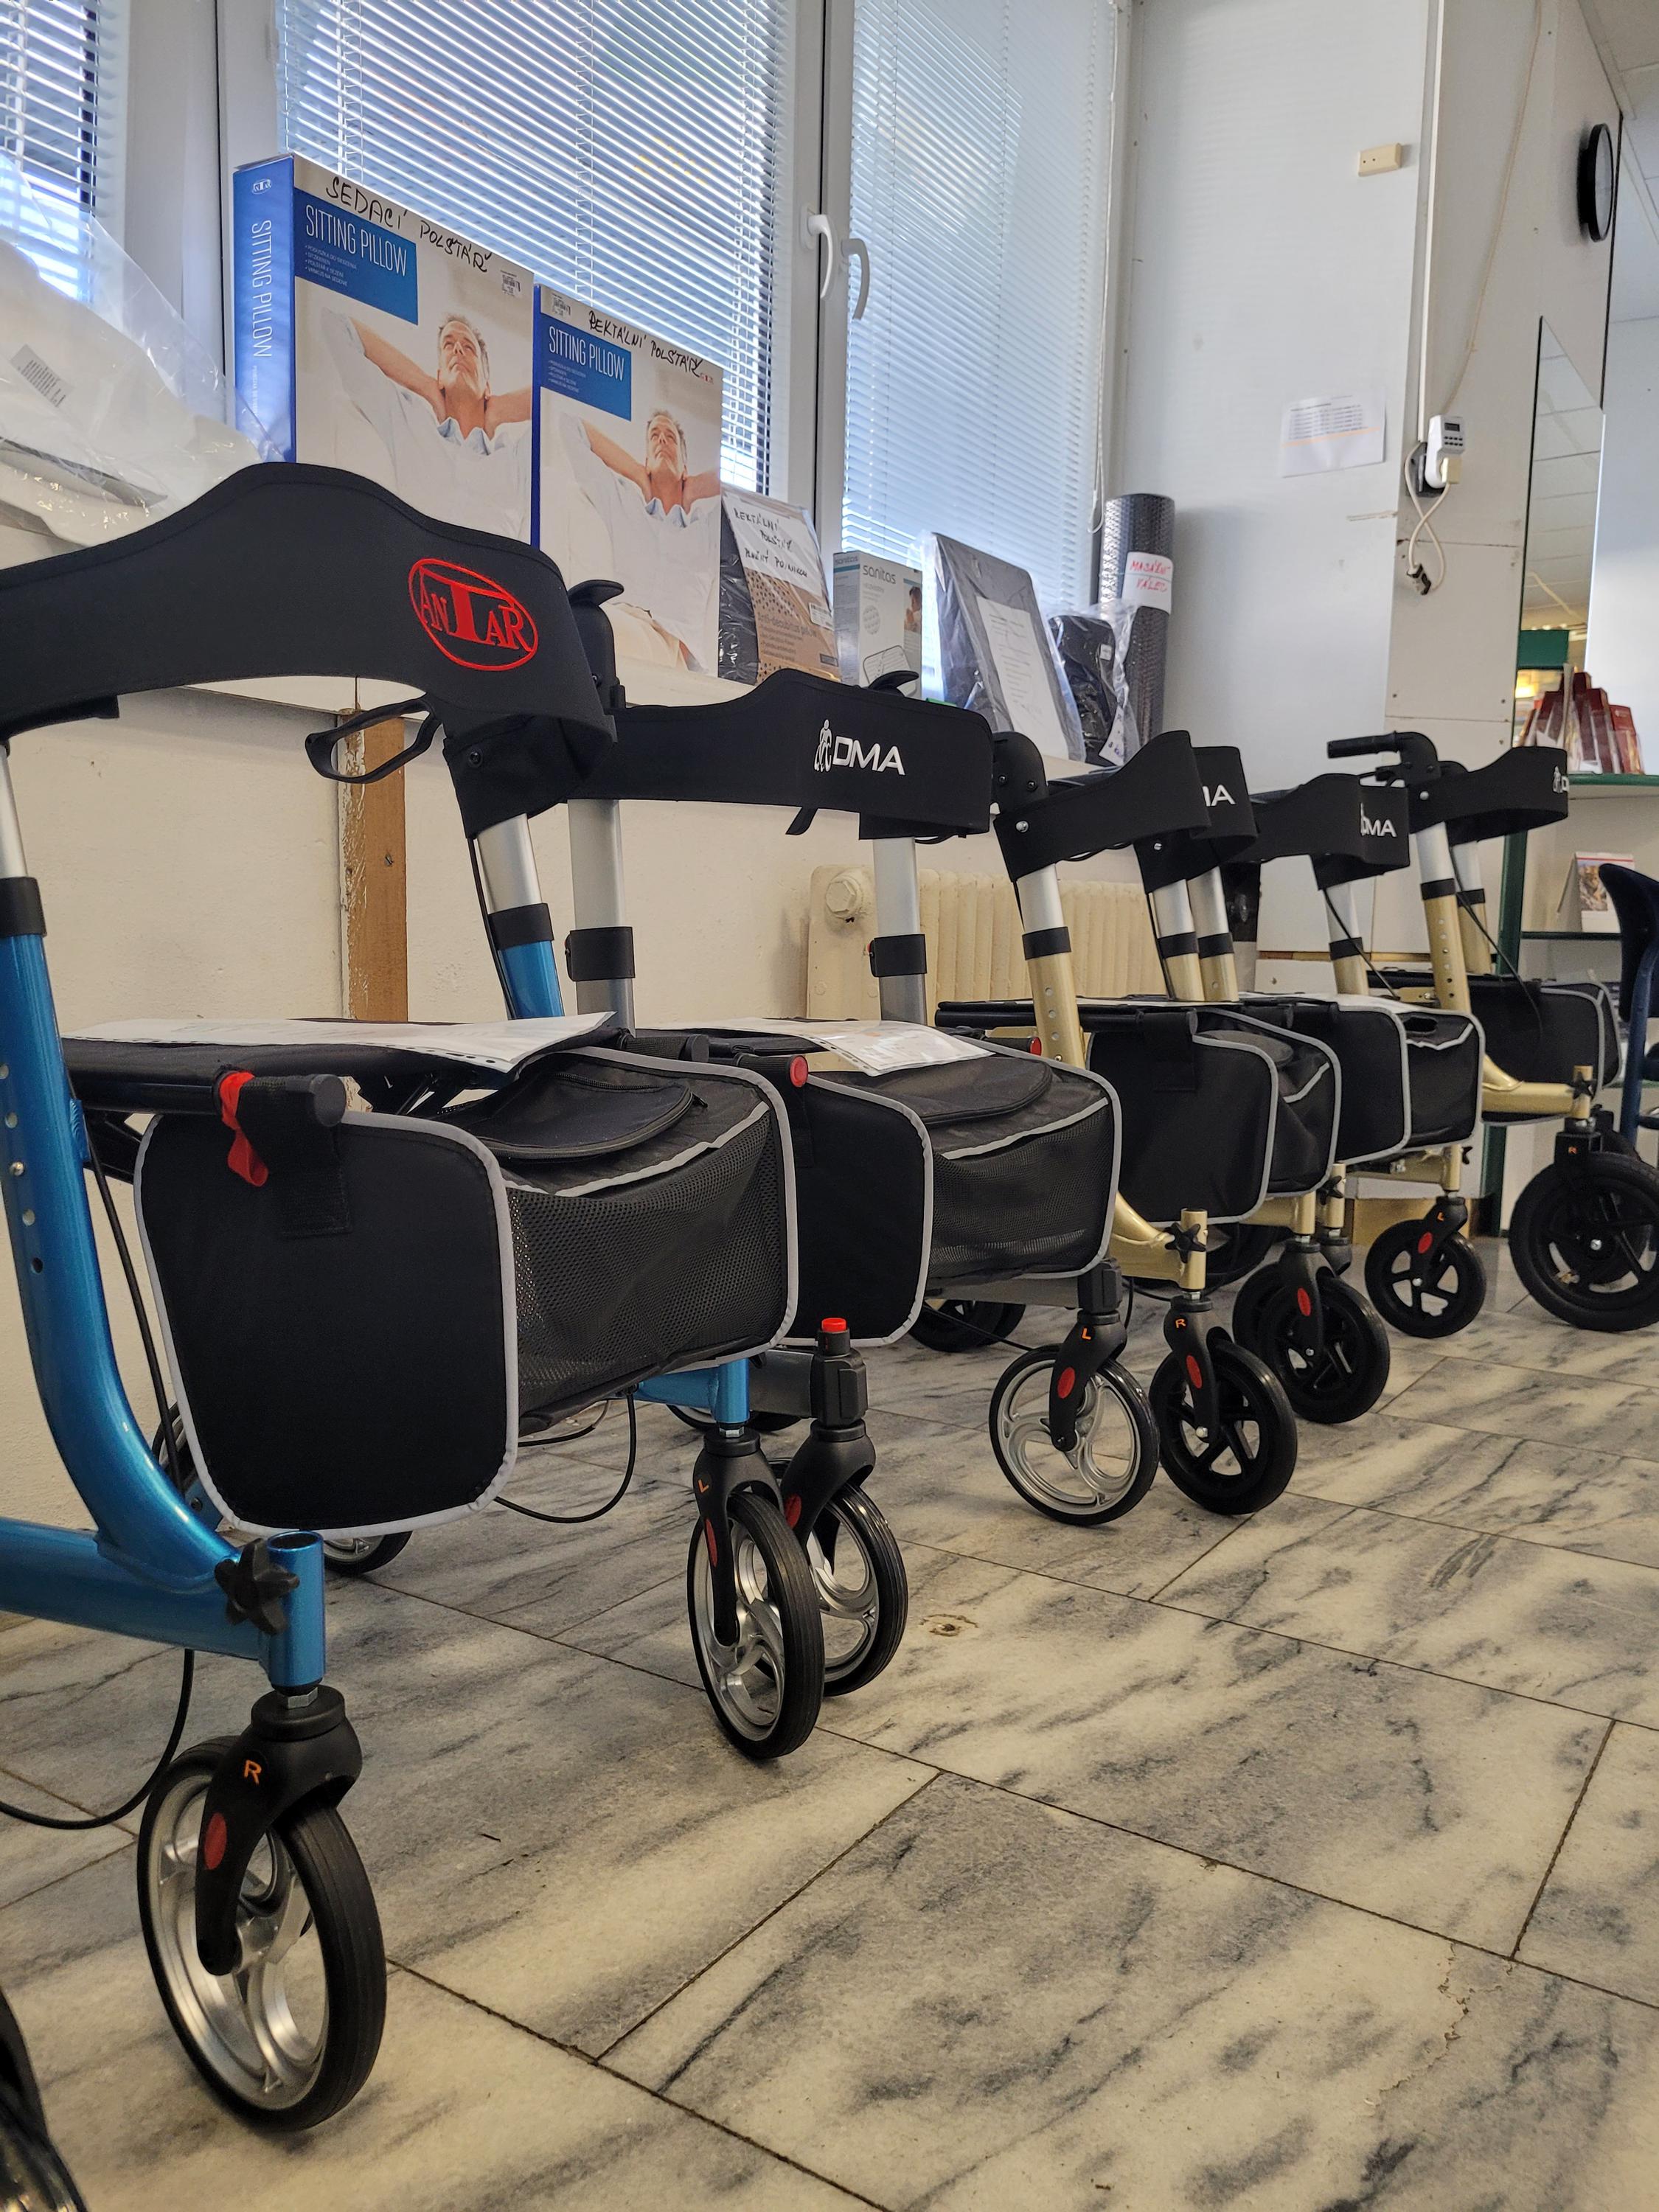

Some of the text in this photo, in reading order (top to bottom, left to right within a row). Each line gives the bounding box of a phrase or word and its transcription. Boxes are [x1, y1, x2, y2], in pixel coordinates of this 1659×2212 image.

[326, 176, 408, 230] SEDACÍ
[305, 204, 407, 276] SITTING PILLOW
[251, 220, 273, 358] SITTING PILLOW
[549, 326, 586, 366] SITTING
[589, 344, 625, 382] PILLOW
[863, 565, 897, 585] sanitas
[832, 736, 906, 776] DMA
[1082, 1327, 1091, 1340] L
[1175, 1318, 1186, 1329] R
[698, 1479, 709, 1493] L
[243, 1759, 262, 1786] R
